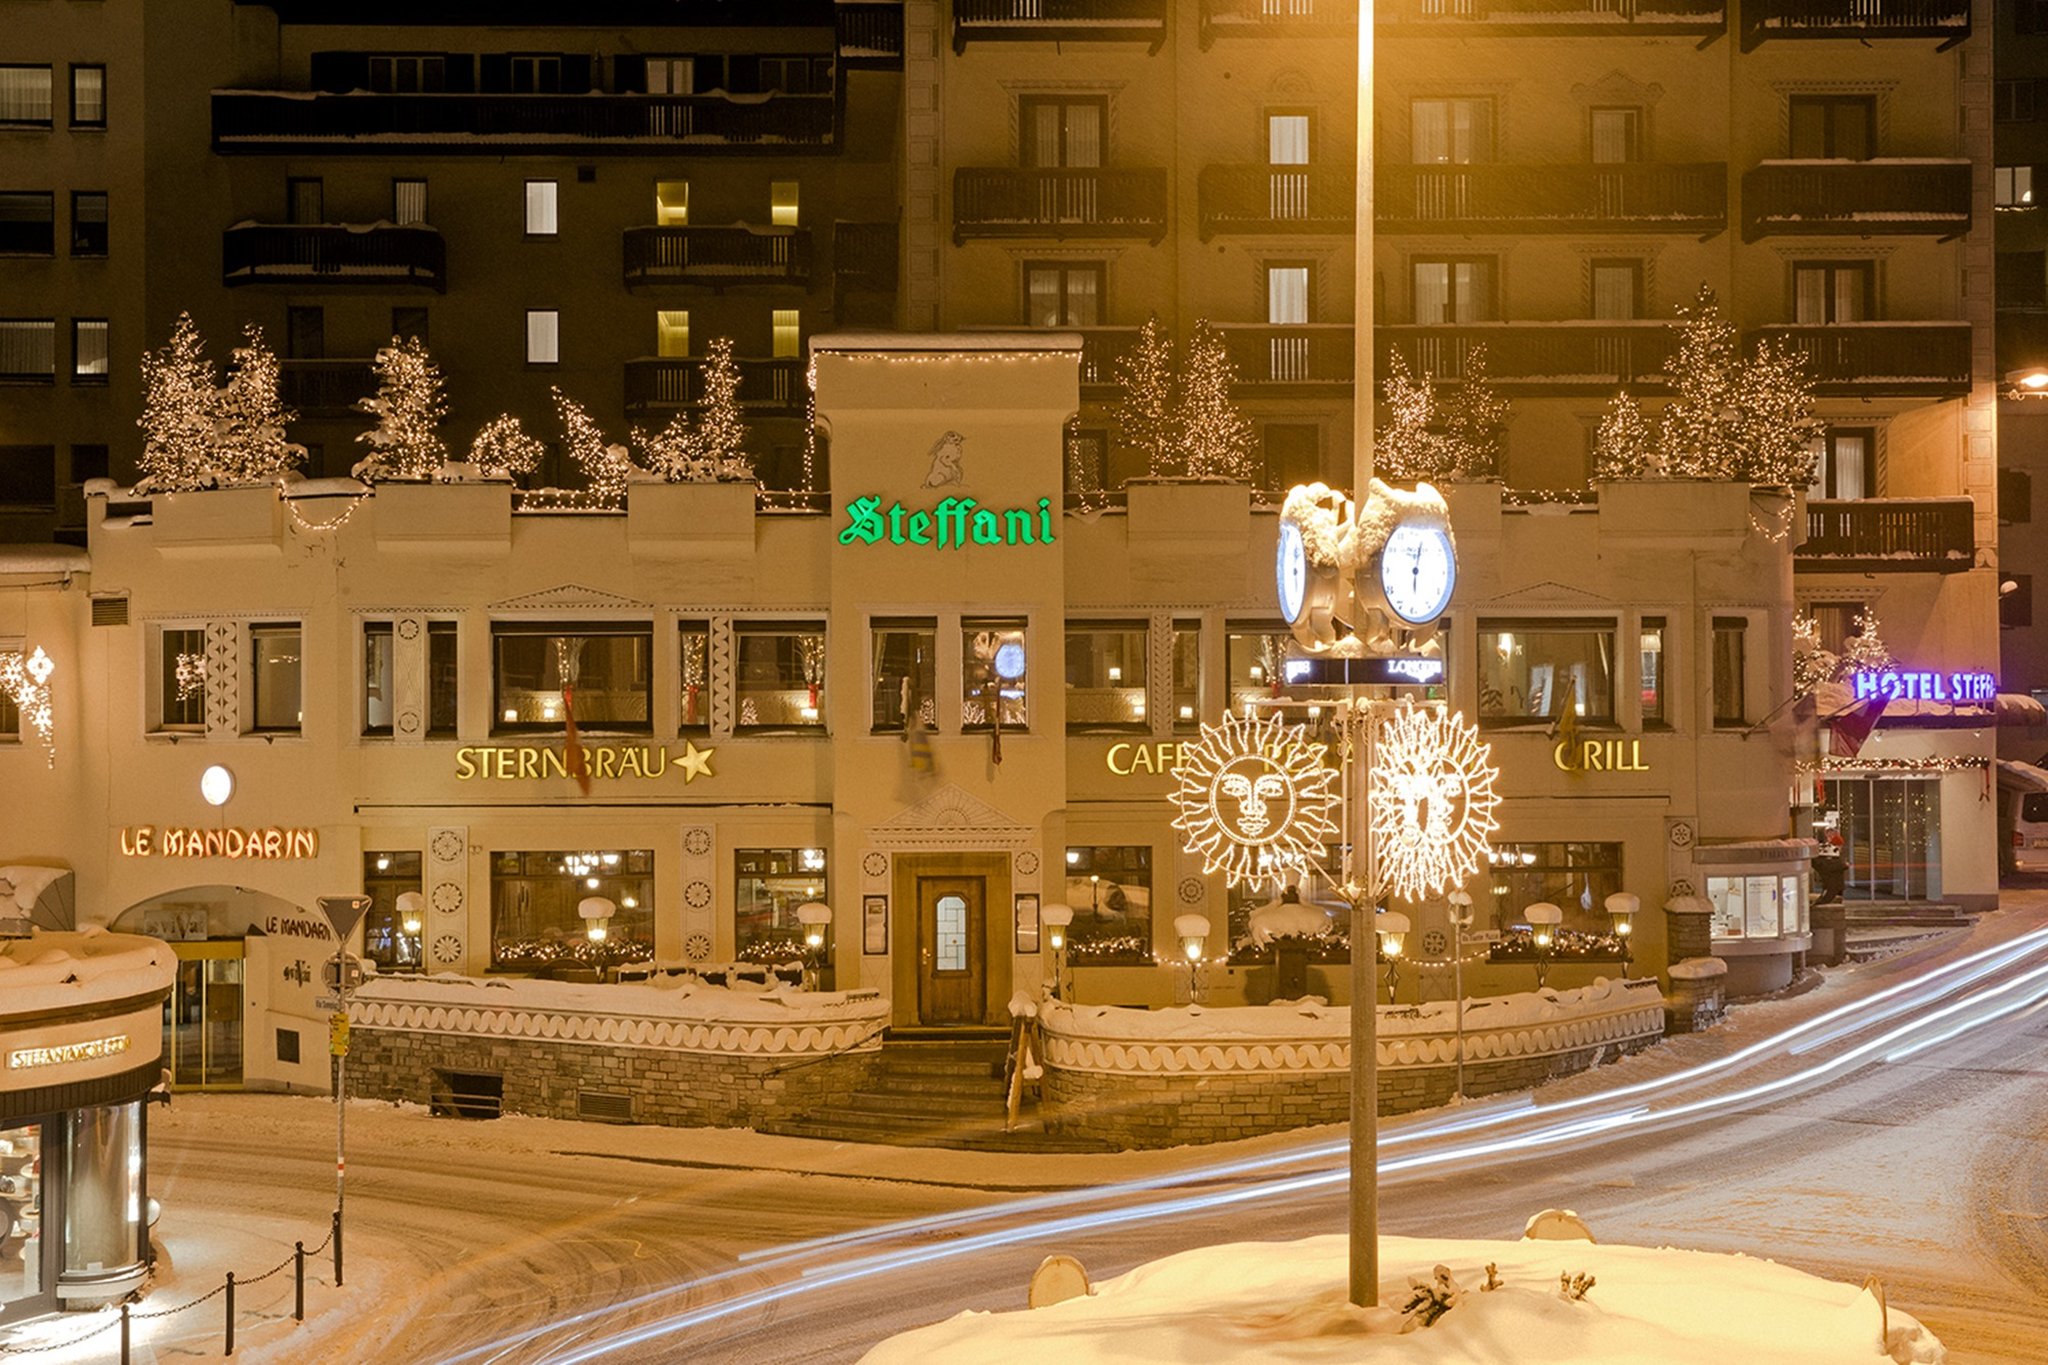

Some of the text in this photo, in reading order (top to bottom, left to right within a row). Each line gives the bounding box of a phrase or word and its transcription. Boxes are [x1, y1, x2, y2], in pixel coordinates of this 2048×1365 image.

[838, 495, 1056, 550] Steffani
[1856, 672, 1946, 700] HOTEL
[455, 746, 666, 780] STERNBRÄU
[120, 828, 317, 859] LE MANDARIN
[265, 916, 278, 934] LE
